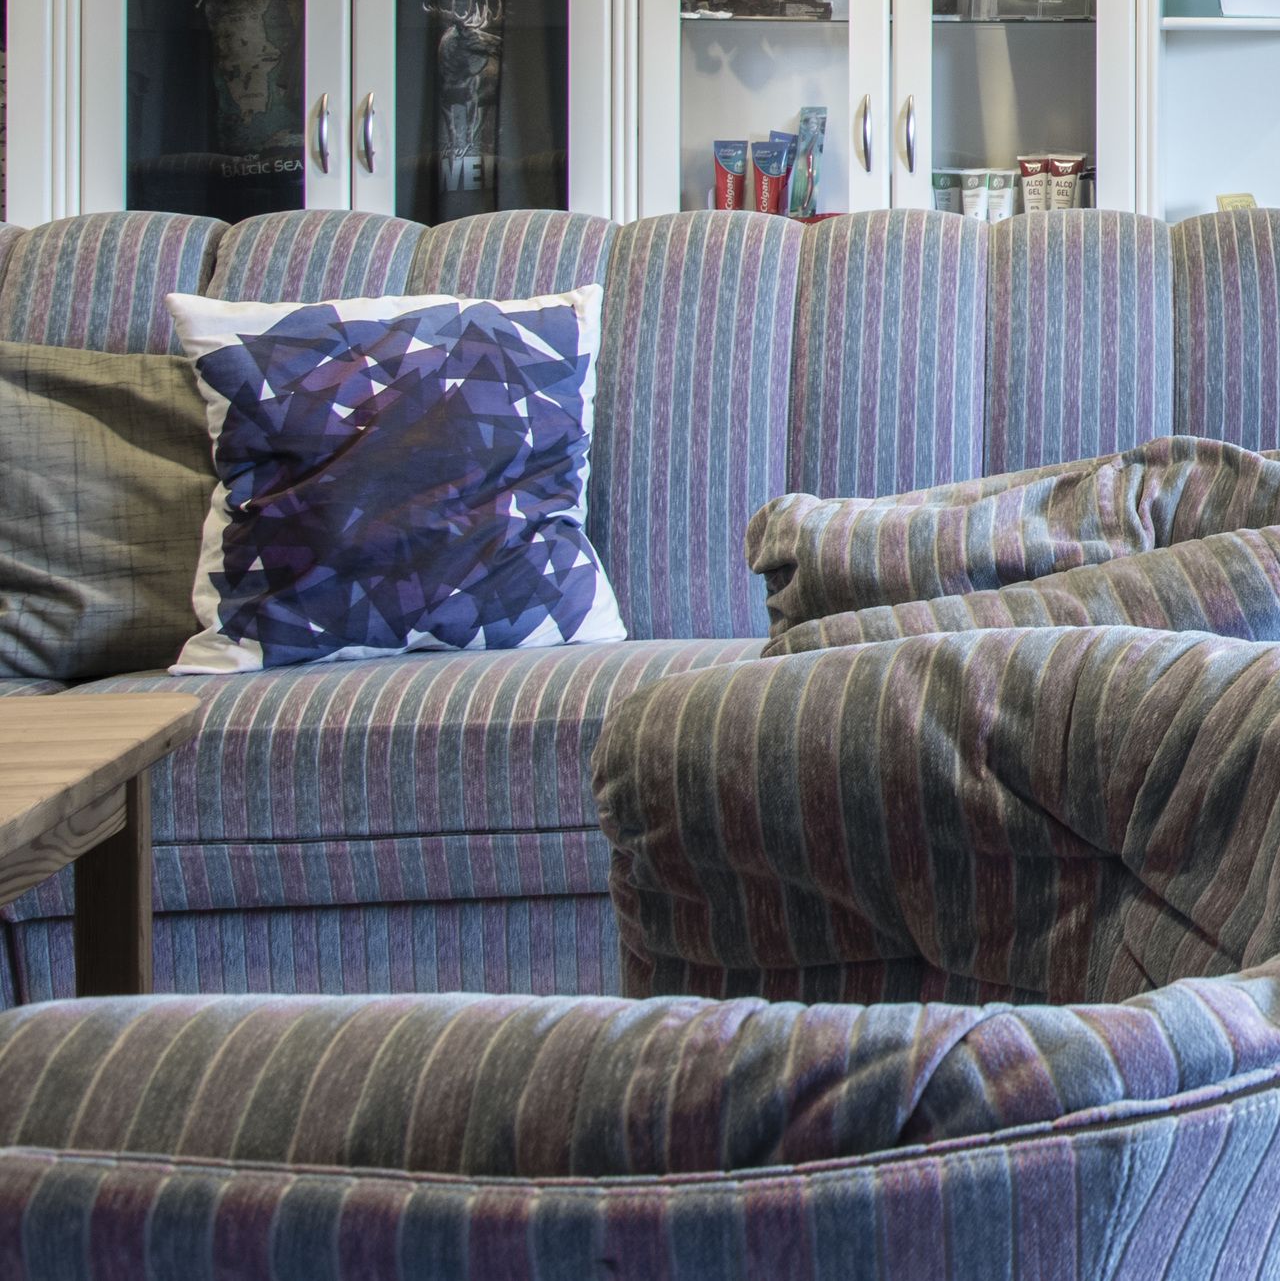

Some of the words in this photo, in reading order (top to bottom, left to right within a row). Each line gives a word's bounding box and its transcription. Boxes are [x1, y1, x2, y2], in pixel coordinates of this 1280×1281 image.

[725, 174, 735, 210] Colgate
[760, 176, 769, 212] Colgate
[1026, 179, 1043, 187] ALCO
[1055, 180, 1073, 188] ALCO
